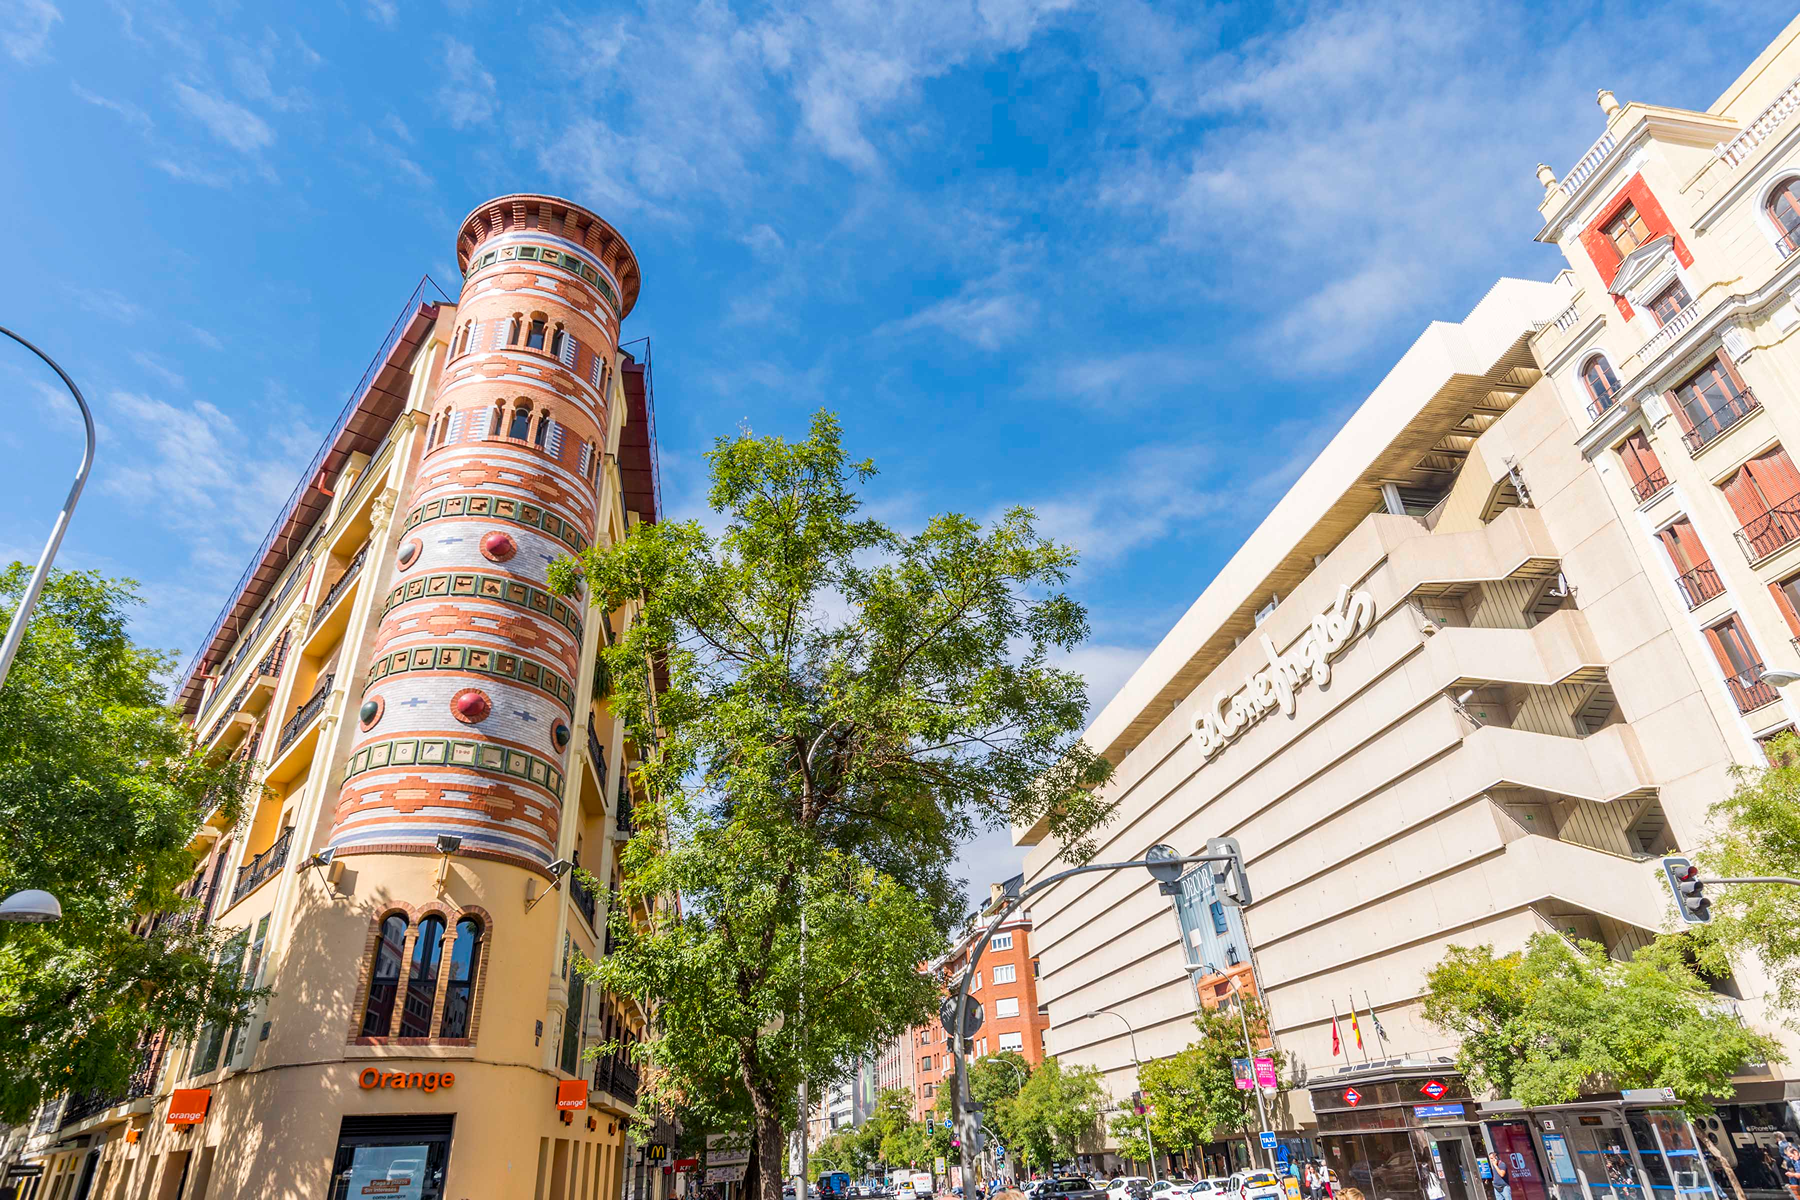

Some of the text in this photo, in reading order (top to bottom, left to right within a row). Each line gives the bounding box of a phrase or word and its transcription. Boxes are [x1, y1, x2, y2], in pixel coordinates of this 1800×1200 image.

[1191, 711, 1225, 756] El
[1212, 672, 1279, 737] Corte
[359, 1067, 456, 1093] Orange
[170, 1112, 201, 1120] orange
